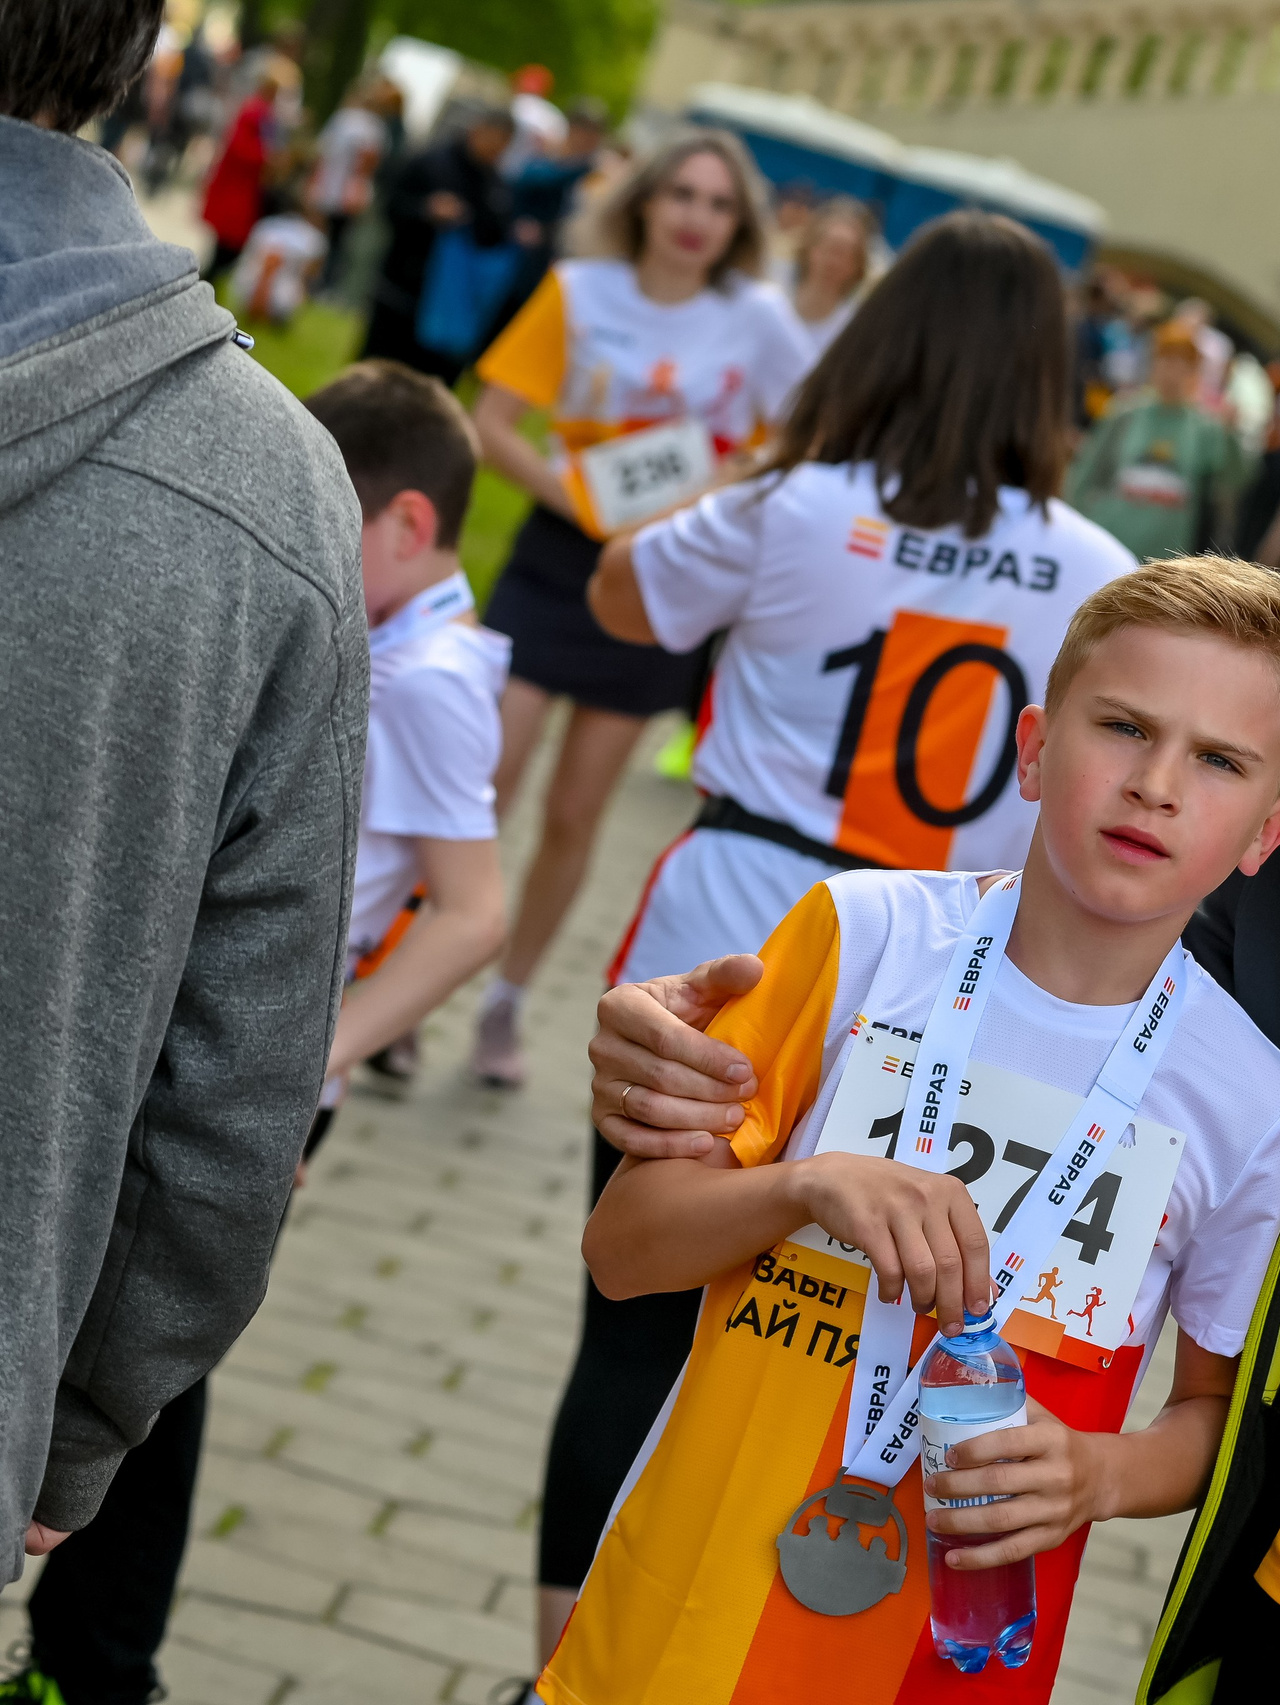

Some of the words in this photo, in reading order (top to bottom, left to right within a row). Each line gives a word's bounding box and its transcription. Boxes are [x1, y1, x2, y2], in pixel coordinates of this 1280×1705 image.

[894, 530, 1060, 591] ЕВРАЗ
[822, 627, 1029, 829] 10
[959, 936, 993, 994] ЕВРАЗ
[1133, 991, 1169, 1053] ЕВРАЗ
[919, 1063, 948, 1134] ЕВРАЗ
[1047, 1139, 1096, 1206] ЕВРАЗ
[725, 1296, 800, 1348] АЙ
[880, 1398, 918, 1464] ВРАЗ
